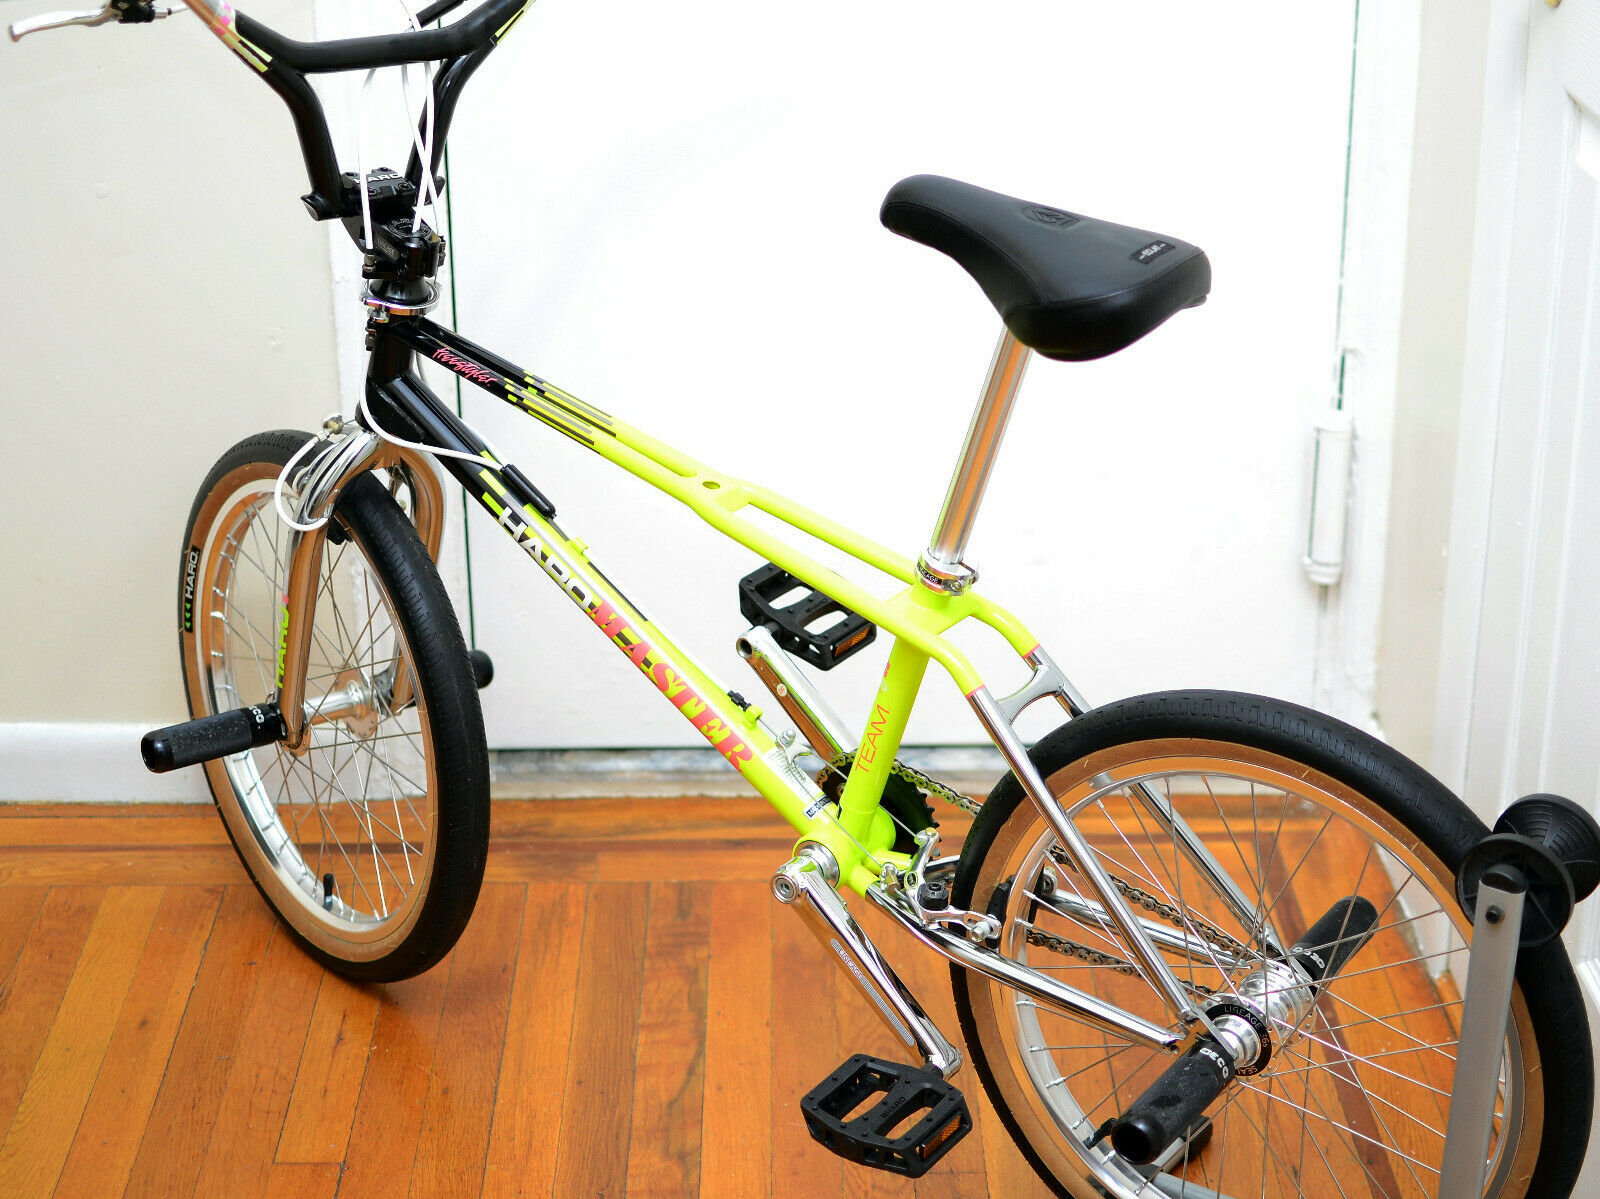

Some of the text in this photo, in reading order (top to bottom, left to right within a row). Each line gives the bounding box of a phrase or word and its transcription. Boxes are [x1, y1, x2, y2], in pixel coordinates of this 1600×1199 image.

[353, 173, 399, 184] ARO
[185, 551, 198, 600] HARO
[499, 506, 752, 773] HARO MASTER
[855, 704, 889, 772] TEAM
[839, 948, 865, 979] LINEAGE
[1224, 1005, 1263, 1030] LINEAGE
[1200, 1047, 1229, 1079] DECO
